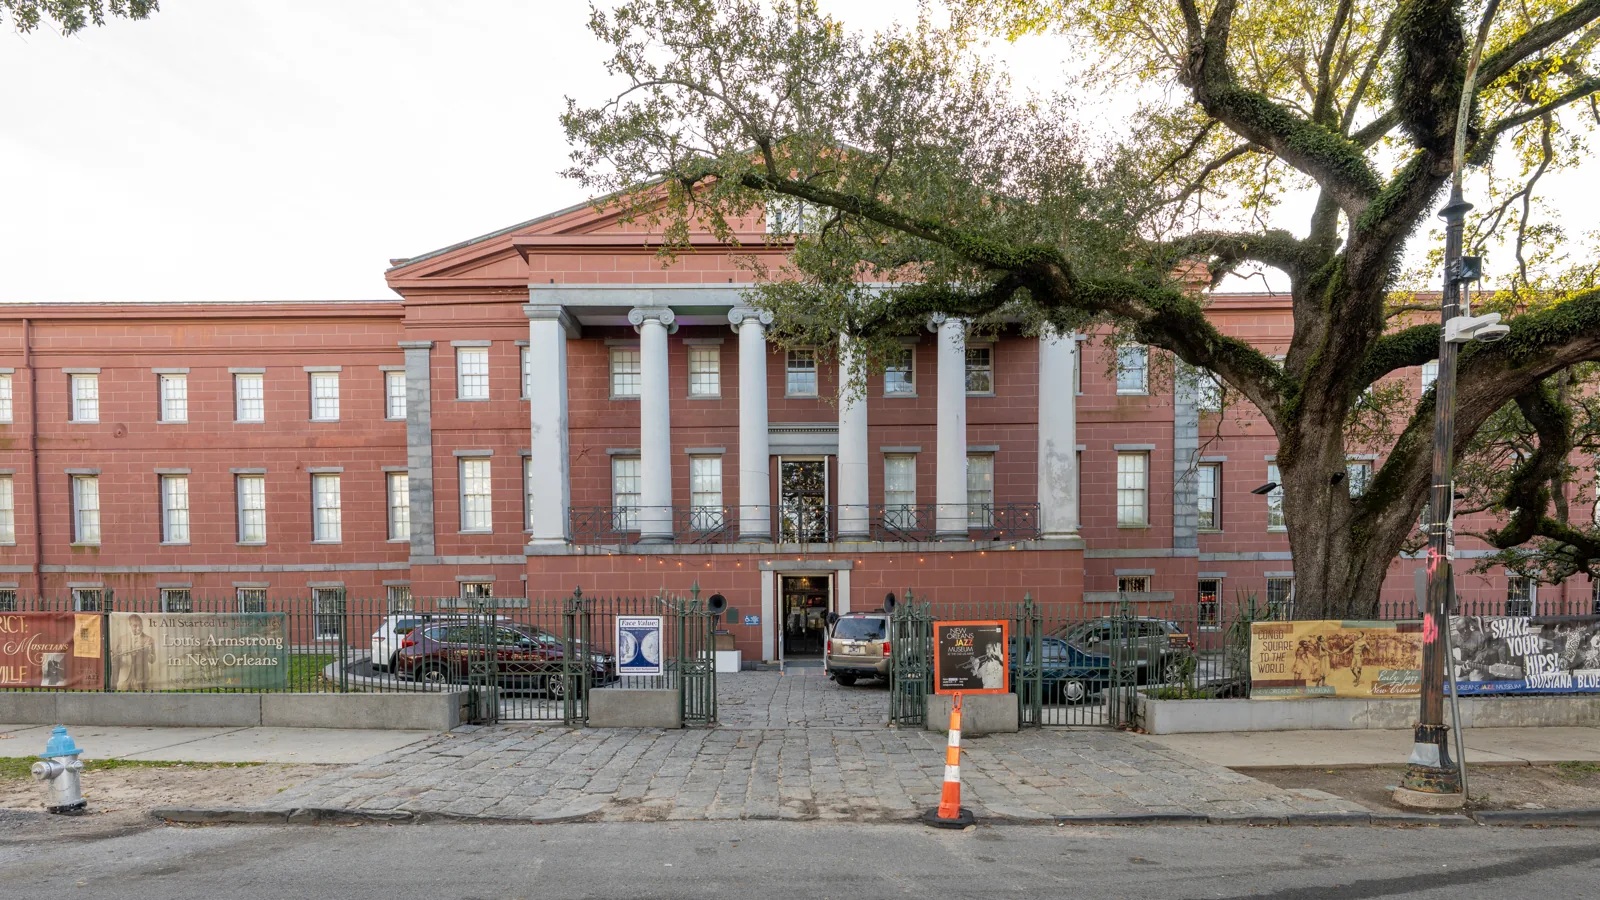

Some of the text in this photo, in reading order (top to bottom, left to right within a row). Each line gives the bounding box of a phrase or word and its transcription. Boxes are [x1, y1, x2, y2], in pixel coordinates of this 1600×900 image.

[149, 618, 157, 627] It
[160, 618, 176, 627] All
[177, 618, 215, 627] Started
[257, 618, 283, 630] Alley
[1491, 617, 1530, 639] SHAKE
[162, 633, 283, 650] Louis Armstrong
[1258, 630, 1284, 640] CONGO
[955, 639, 973, 647] JAZZ
[1262, 641, 1294, 652] SQUARE
[1507, 635, 1540, 657] YOUR
[168, 653, 278, 666] in New Orleans
[1260, 652, 1287, 663] TO THE
[1526, 652, 1559, 676] HIPS!
[1377, 670, 1419, 685] Early Jazz
[1525, 674, 1573, 689] LOUISIANA
[1367, 682, 1421, 695] New Orleans
